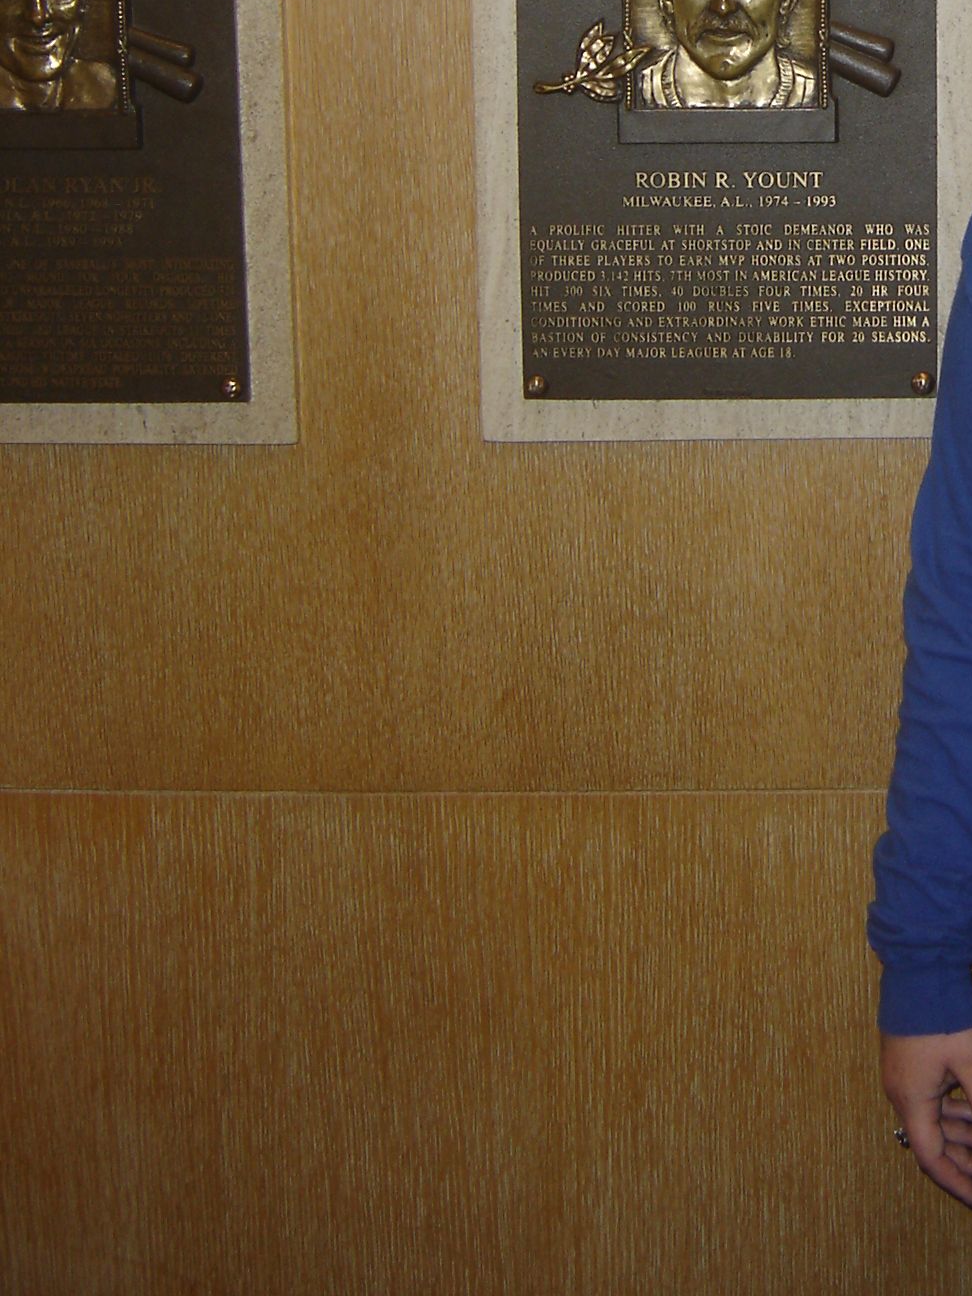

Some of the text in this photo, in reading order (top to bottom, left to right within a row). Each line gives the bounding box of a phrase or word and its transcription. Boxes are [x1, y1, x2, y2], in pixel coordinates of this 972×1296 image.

[635, 171, 824, 189] ROBIN R. YOUNT
[758, 195, 788, 208] 1974
[806, 195, 837, 208] 1993
[550, 224, 930, 236] PROLIFIC HITTER WITH A STOIC DEMEANOR WHO WAS
[590, 239, 653, 251] GRACEFUL
[660, 239, 676, 251] AT
[681, 239, 751, 251] SHORTSTOP
[756, 239, 783, 251] AND
[788, 239, 801, 251] IN
[806, 239, 855, 251] CENTER
[905, 239, 930, 251] ONE
[552, 255, 856, 267] THREE PLAYERS TO EARN MVP HONORS TWO
[752, 270, 817, 282] AMERICAN
[821, 270, 871, 282] LEAGUE
[692, 285, 930, 297] DOUBLES FOUR 20 HR FOUR
[579, 301, 930, 313] AND SCORED RUNS FIVE EXCEPTIONAL
[658, 316, 762, 328] EXTRAORDINARY
[768, 316, 804, 328] WORK
[810, 316, 846, 328] ETHIC
[852, 316, 887, 328] MADE
[893, 316, 917, 328] HIM
[613, 332, 698, 344] CONSISTENCY
[738, 332, 814, 344] DURABILITY
[821, 332, 845, 344] FOR
[625, 347, 775, 359] MAJOR LEAGUER AGE
